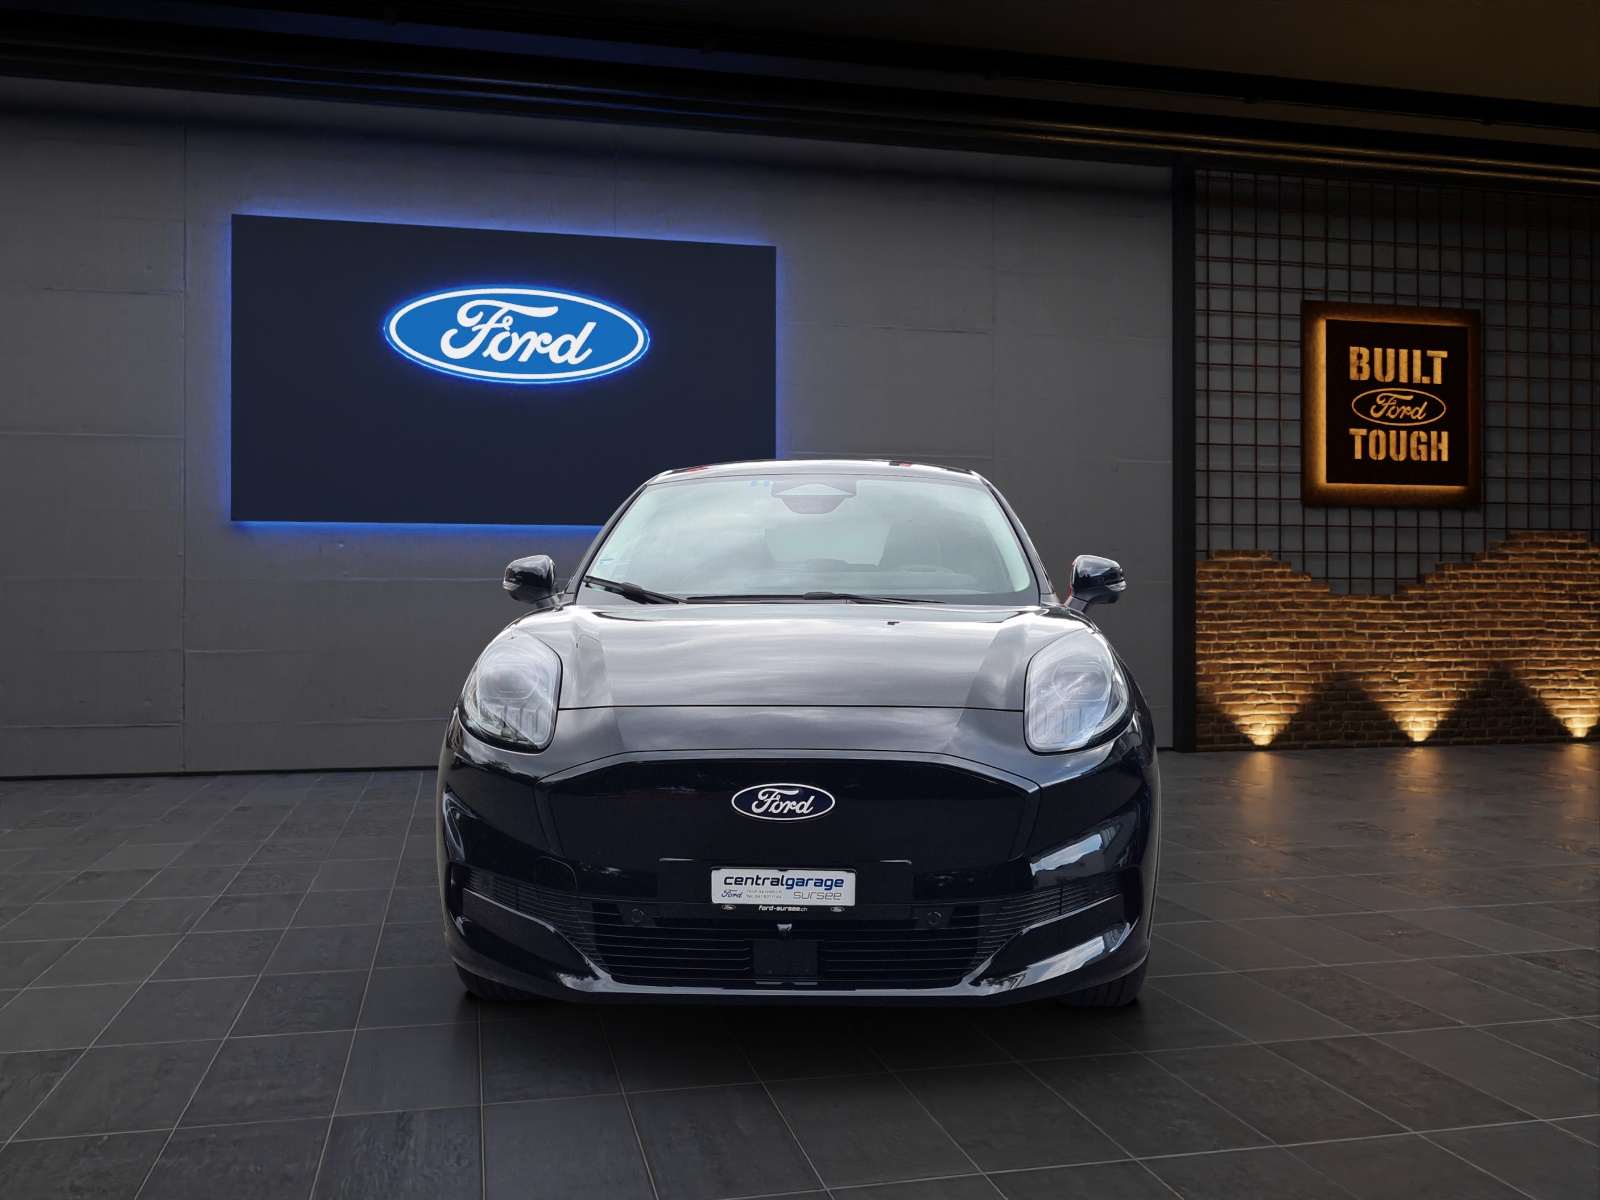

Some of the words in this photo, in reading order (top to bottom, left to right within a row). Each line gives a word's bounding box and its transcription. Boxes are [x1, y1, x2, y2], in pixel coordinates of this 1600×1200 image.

[440, 299, 597, 365] Ford
[1349, 345, 1448, 384] BUILT
[1370, 392, 1428, 420] Ford
[1349, 428, 1449, 462] TOUGH
[751, 788, 815, 814] Ford
[721, 889, 743, 899] Ford
[723, 874, 845, 891] centralgarage
[758, 904, 808, 912] ford-sursee.ch
